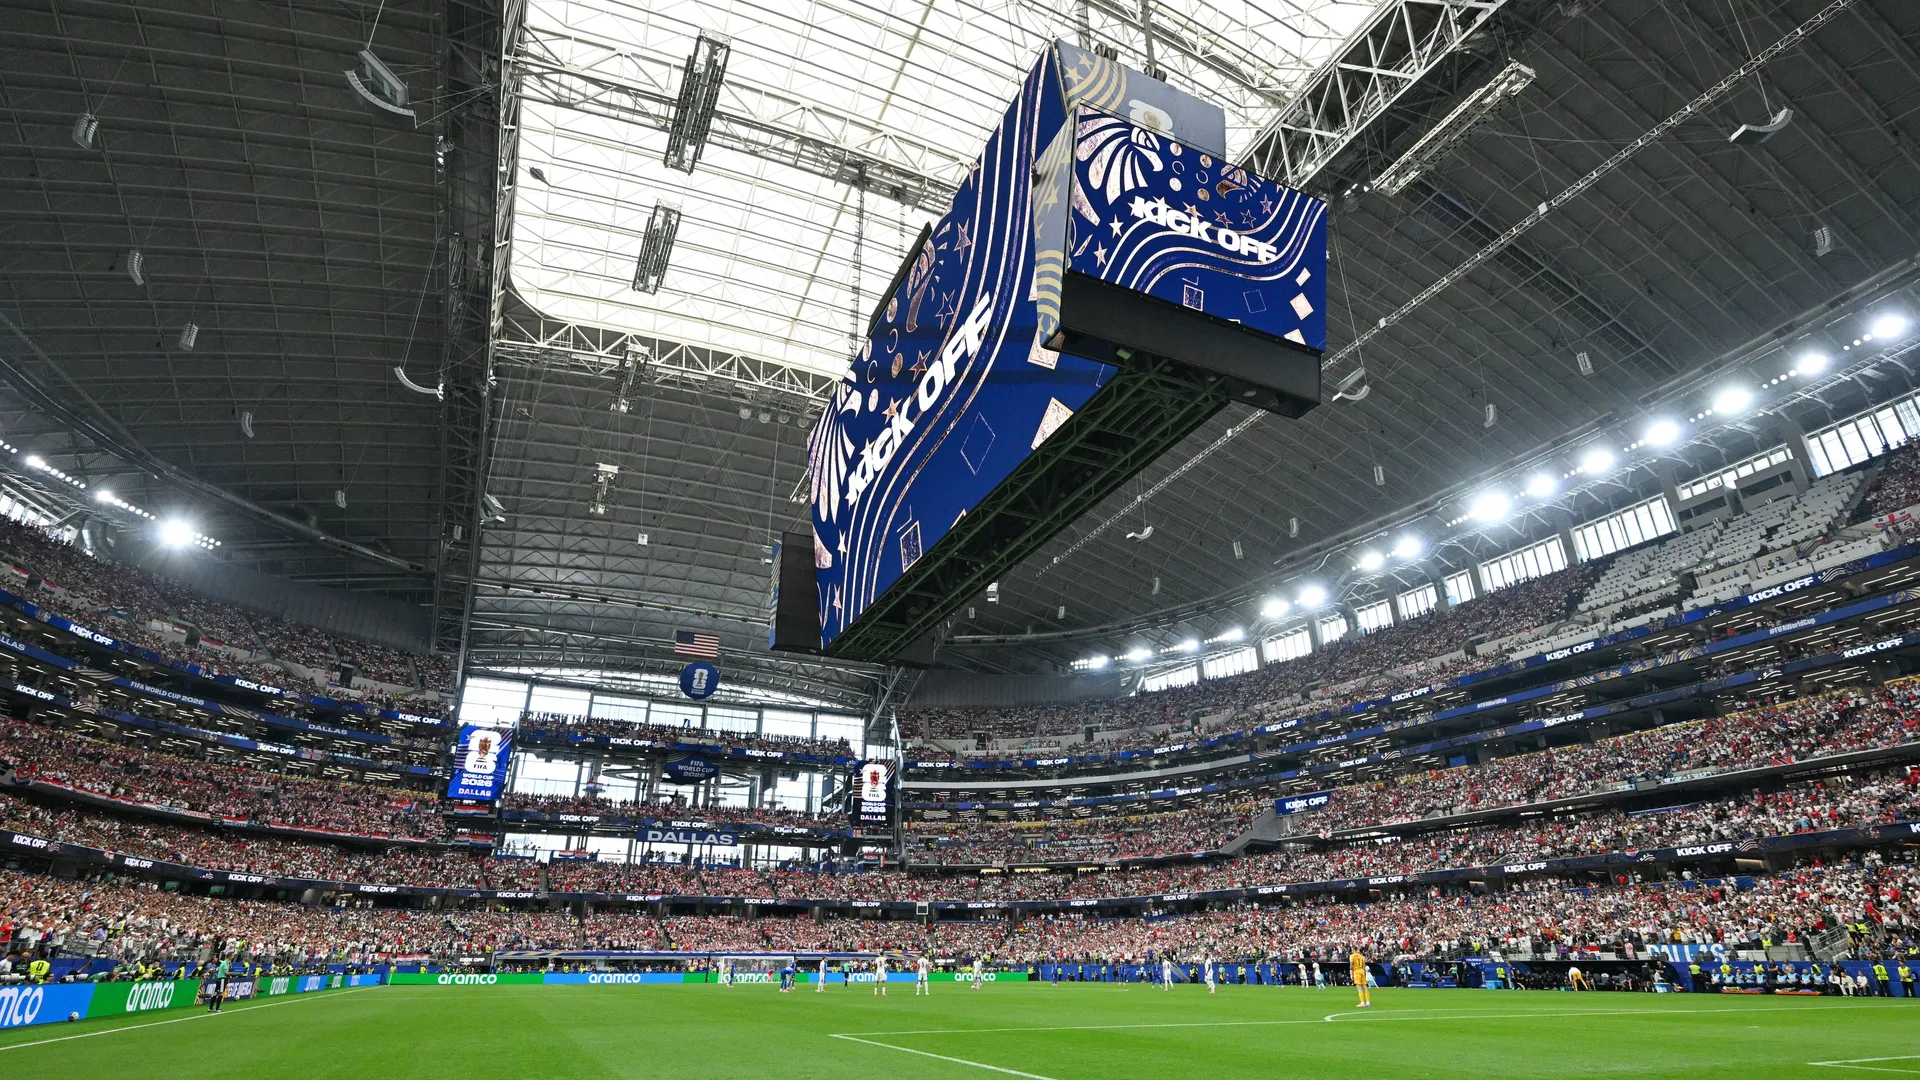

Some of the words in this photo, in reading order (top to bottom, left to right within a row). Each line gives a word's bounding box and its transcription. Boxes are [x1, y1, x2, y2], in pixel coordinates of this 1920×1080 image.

[1130, 196, 1212, 243] KICK
[1217, 228, 1277, 263] OFF
[847, 396, 915, 506] KICK
[918, 291, 991, 411] OFF
[1748, 585, 1783, 603] KICK
[1784, 577, 1814, 592] OFF
[1769, 618, 1816, 635] #FIFAWorldCup
[69, 623, 93, 641] KICK
[93, 632, 114, 646] OFF
[1546, 646, 1572, 662] KICK
[1573, 642, 1595, 654] OFF
[1844, 644, 1876, 658] KICK
[1876, 638, 1904, 651] OFF
[16, 684, 37, 697] KICK
[38, 690, 55, 701] OFF
[130, 681, 145, 692] FIFA
[145, 685, 166, 696] WORLD
[167, 690, 182, 700] CUP
[182, 695, 204, 706] 2026
[235, 678, 258, 692] KICK
[260, 684, 280, 696] OFF
[1392, 692, 1412, 702] KICK
[1412, 686, 1430, 698] OFF
[398, 712, 421, 722] KICK
[422, 716, 442, 726] OFF
[1544, 715, 1566, 727] KICK
[1566, 712, 1584, 722] OFF
[308, 724, 348, 736] DALLAS
[1265, 723, 1282, 732] KICK
[1282, 720, 1298, 728] OFF
[610, 738, 632, 746] KICK
[1317, 734, 1348, 745] DALLAS
[280, 746, 296, 756] OFF
[1153, 746, 1170, 754] KICK
[1170, 744, 1184, 752] OFF
[1340, 760, 1354, 768] KICK
[1354, 758, 1368, 766] OFF
[460, 778, 493, 787] 2026
[458, 788, 492, 797] DALLAS
[1285, 798, 1308, 810] KICK
[1308, 796, 1328, 806] OFF
[672, 820, 690, 828] KICK
[860, 814, 886, 822] DALLAS
[12, 834, 32, 846] KICK
[32, 838, 48, 849] OFF
[647, 830, 733, 845] DALLAS
[1676, 846, 1707, 857] KICK
[1708, 844, 1732, 854] OFF
[124, 857, 140, 867] KICK
[140, 860, 154, 868] OFF
[1504, 864, 1526, 874] KICK
[1526, 862, 1547, 872] OFF
[228, 873, 247, 882] KICK
[248, 875, 263, 883] OFF
[360, 884, 378, 892] KICK
[378, 886, 398, 894] OFF
[438, 974, 497, 984] aramco
[588, 973, 641, 984] aramco
[126, 982, 174, 1012] aramco
